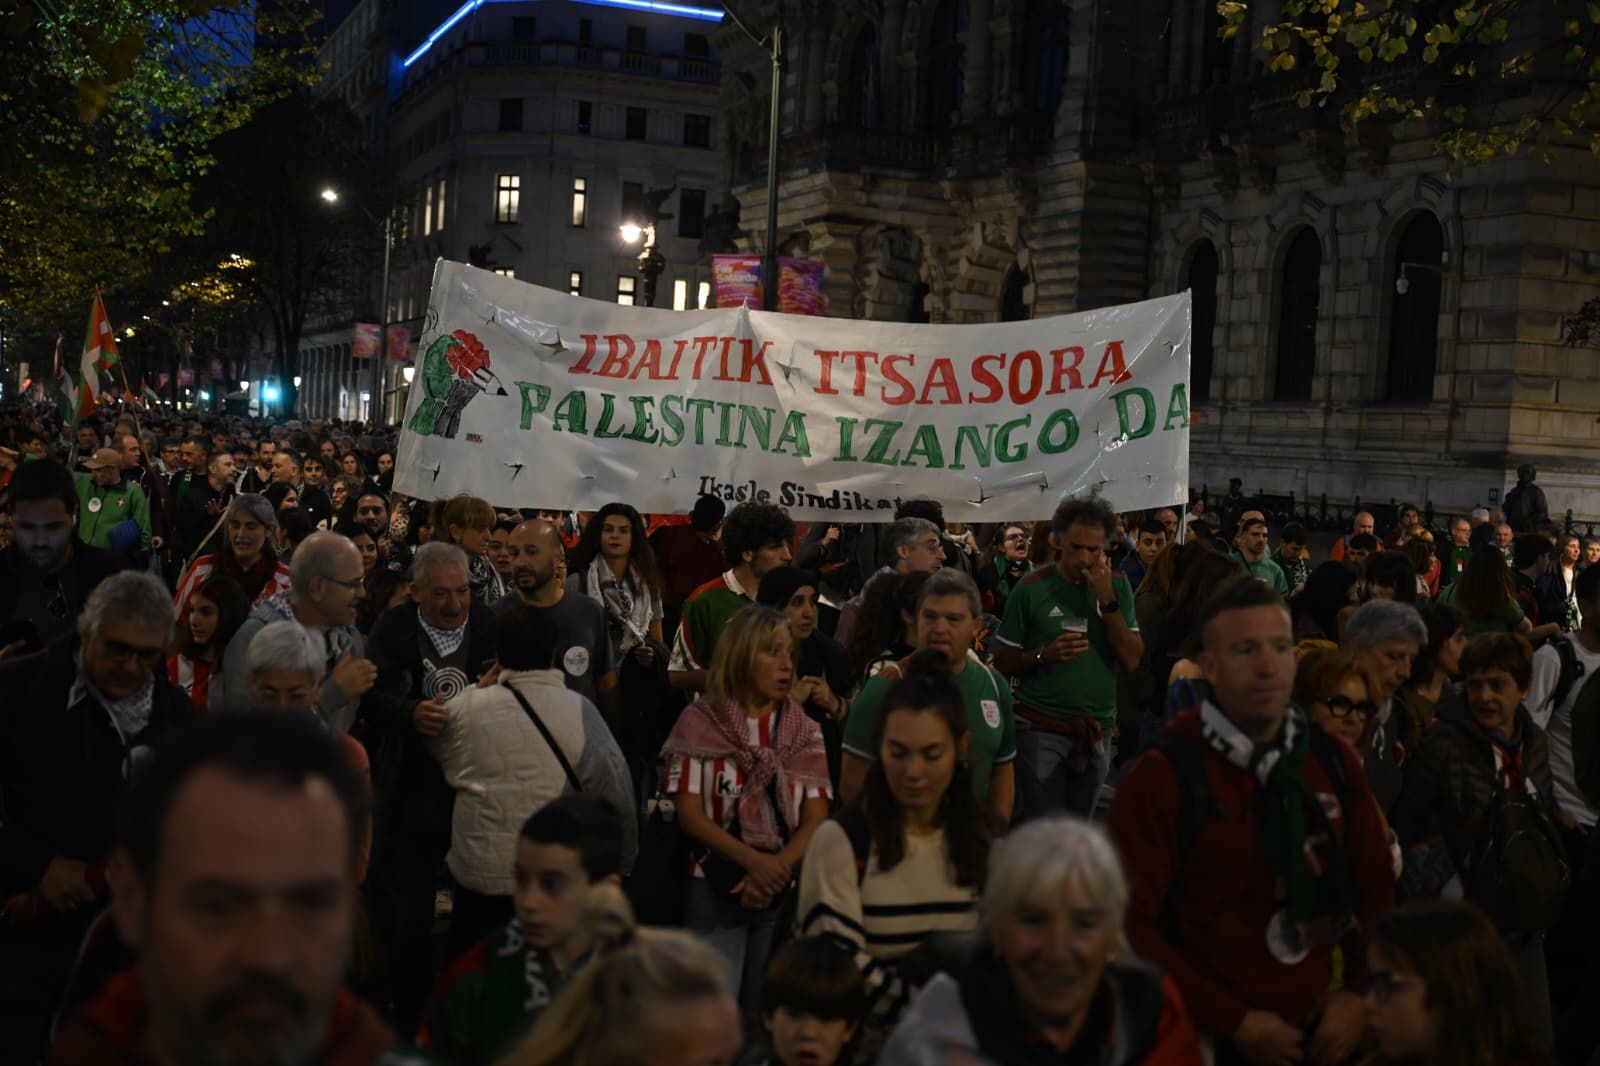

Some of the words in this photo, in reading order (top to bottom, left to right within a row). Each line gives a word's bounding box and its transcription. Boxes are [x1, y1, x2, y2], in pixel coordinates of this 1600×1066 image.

[568, 333, 774, 386] IBAITIK
[813, 340, 1134, 406] ITSASORA
[513, 381, 812, 458] PALESTINA
[832, 408, 1081, 470] IZANGO
[1108, 382, 1190, 443] DA
[697, 475, 771, 504] Ikasle
[779, 481, 904, 511] Sindikat
